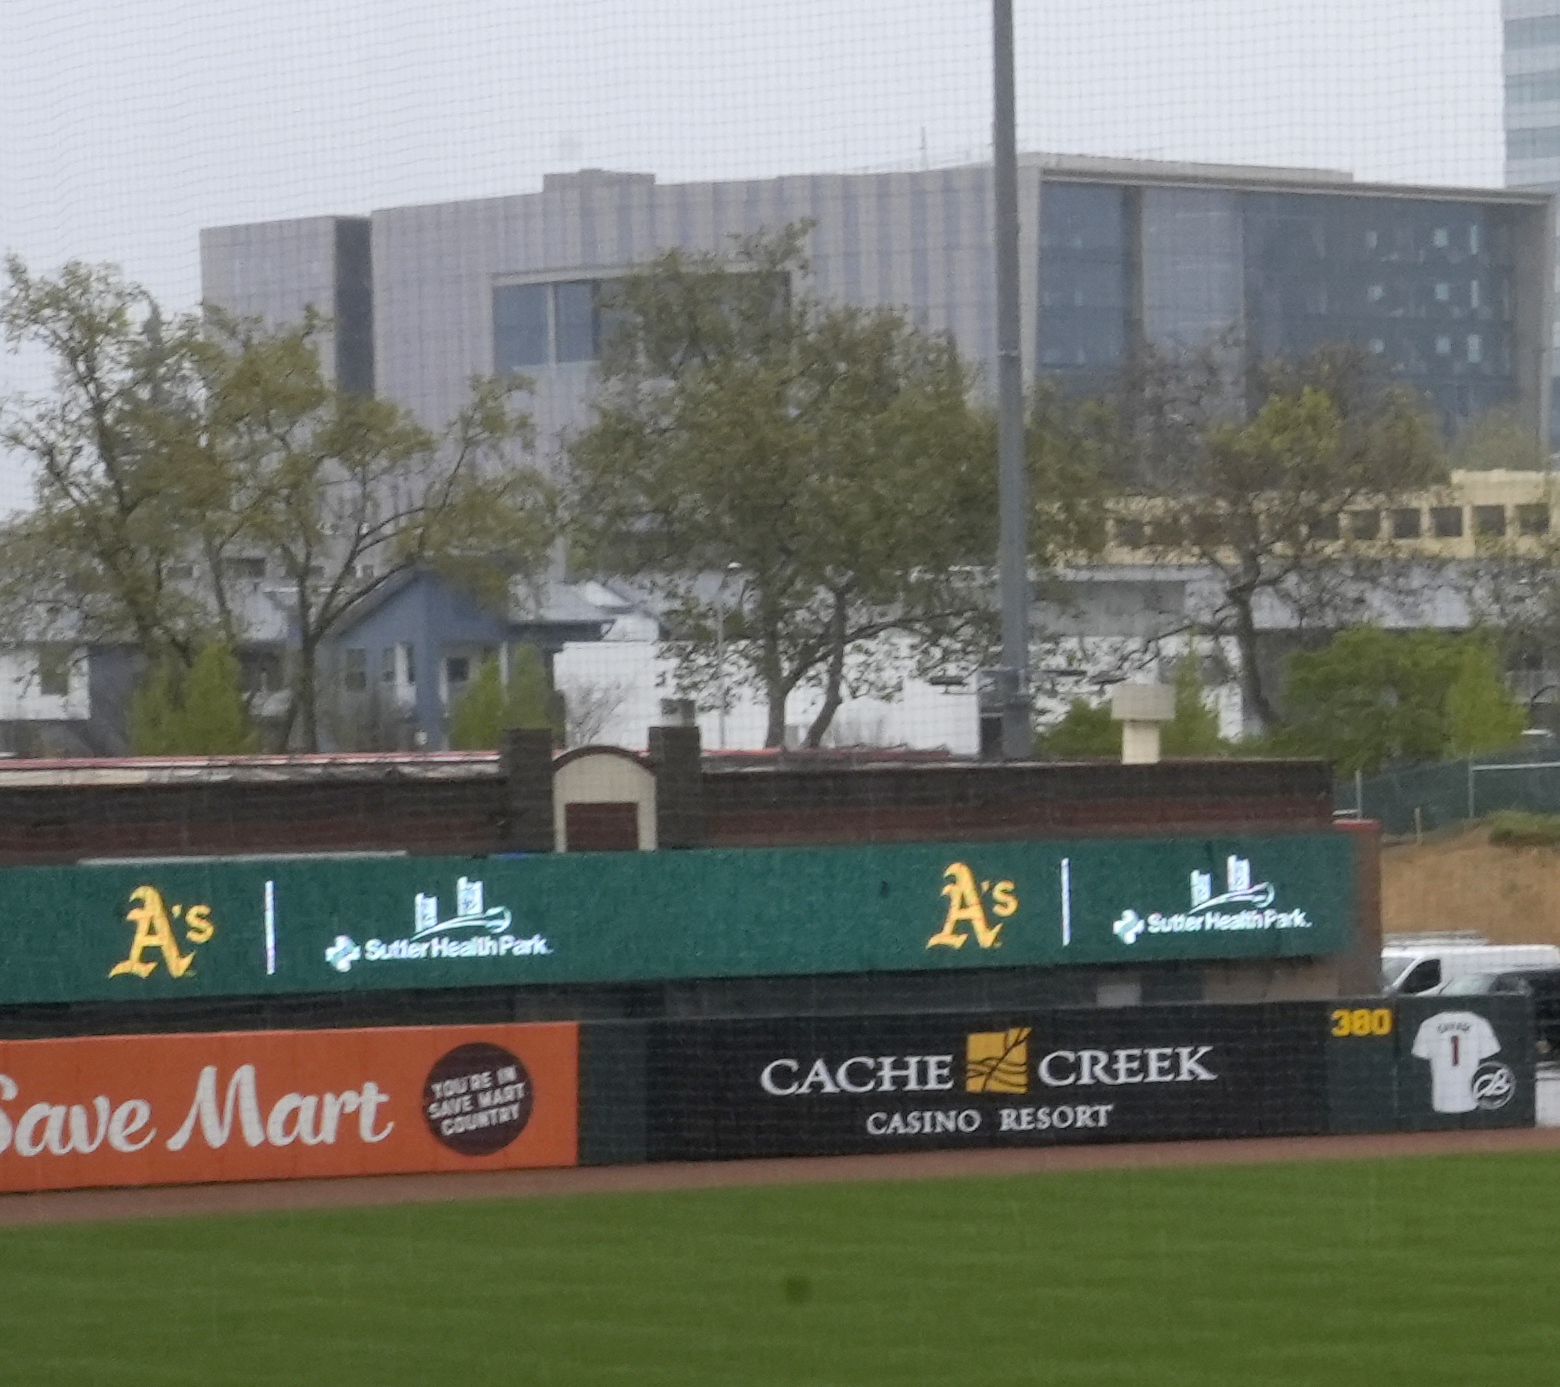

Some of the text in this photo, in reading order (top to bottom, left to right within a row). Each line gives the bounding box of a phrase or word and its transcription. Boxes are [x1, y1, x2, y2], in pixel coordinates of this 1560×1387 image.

[926, 861, 1019, 949] A's
[1147, 908, 1307, 933] Sutter Health Park
[108, 885, 214, 979] A's
[365, 934, 550, 961] Sutter Health Park
[1331, 1008, 1393, 1037] 380
[1450, 1035, 1459, 1066] 1
[760, 1046, 1217, 1096] CACHE CREEK
[166, 1063, 395, 1151] Mart
[867, 1104, 1114, 1135] CASINO RESORT
